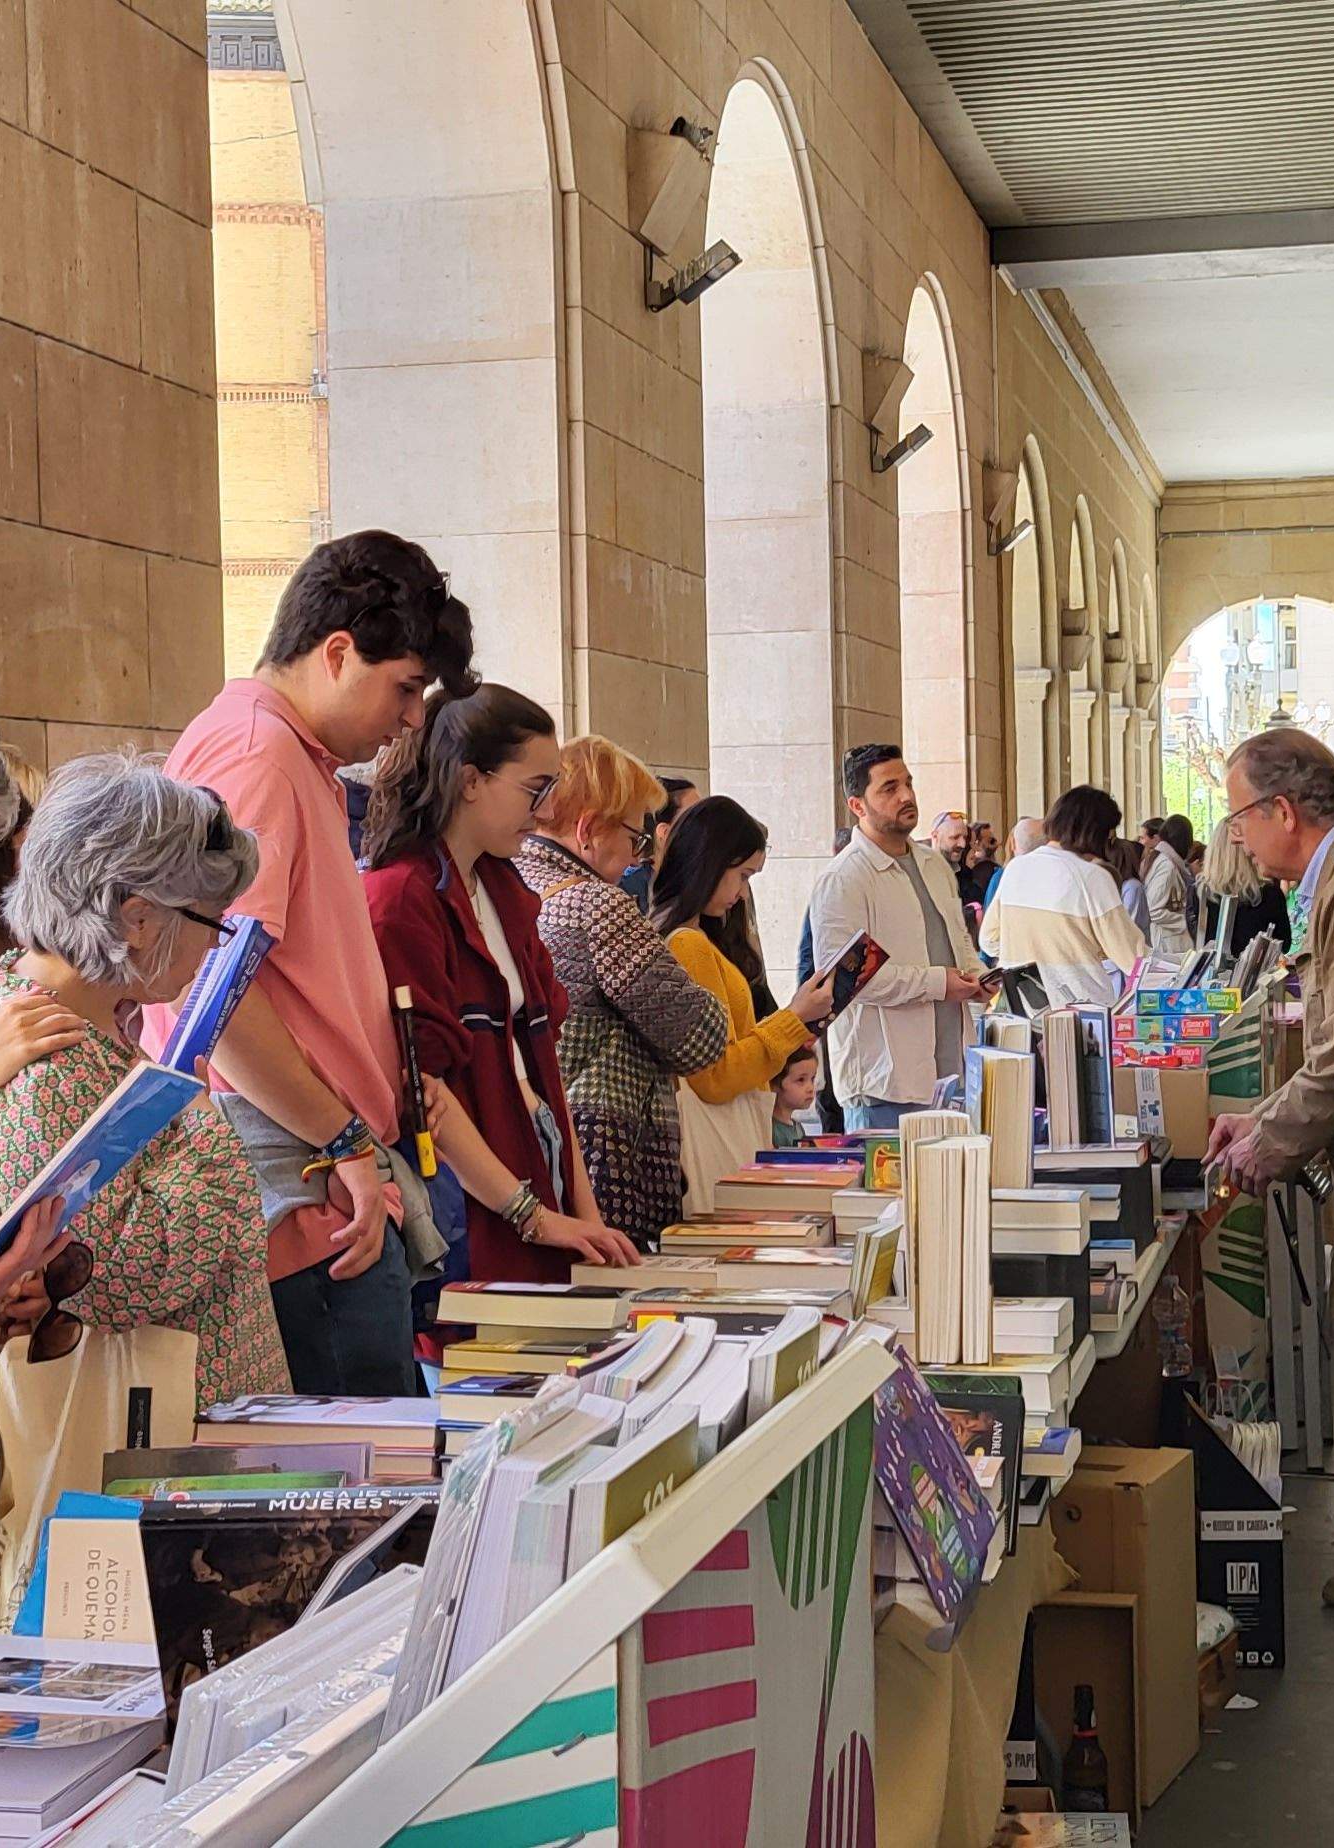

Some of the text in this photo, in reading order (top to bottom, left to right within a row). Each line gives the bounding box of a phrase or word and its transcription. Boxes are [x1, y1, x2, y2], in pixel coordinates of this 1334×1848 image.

[268, 1497, 383, 1512] MUJERES
[87, 1549, 101, 1572] DE
[1229, 1562, 1259, 1592] IPA
[101, 1558, 119, 1642] ALCOHOL
[202, 1628, 216, 1659] Sergio
